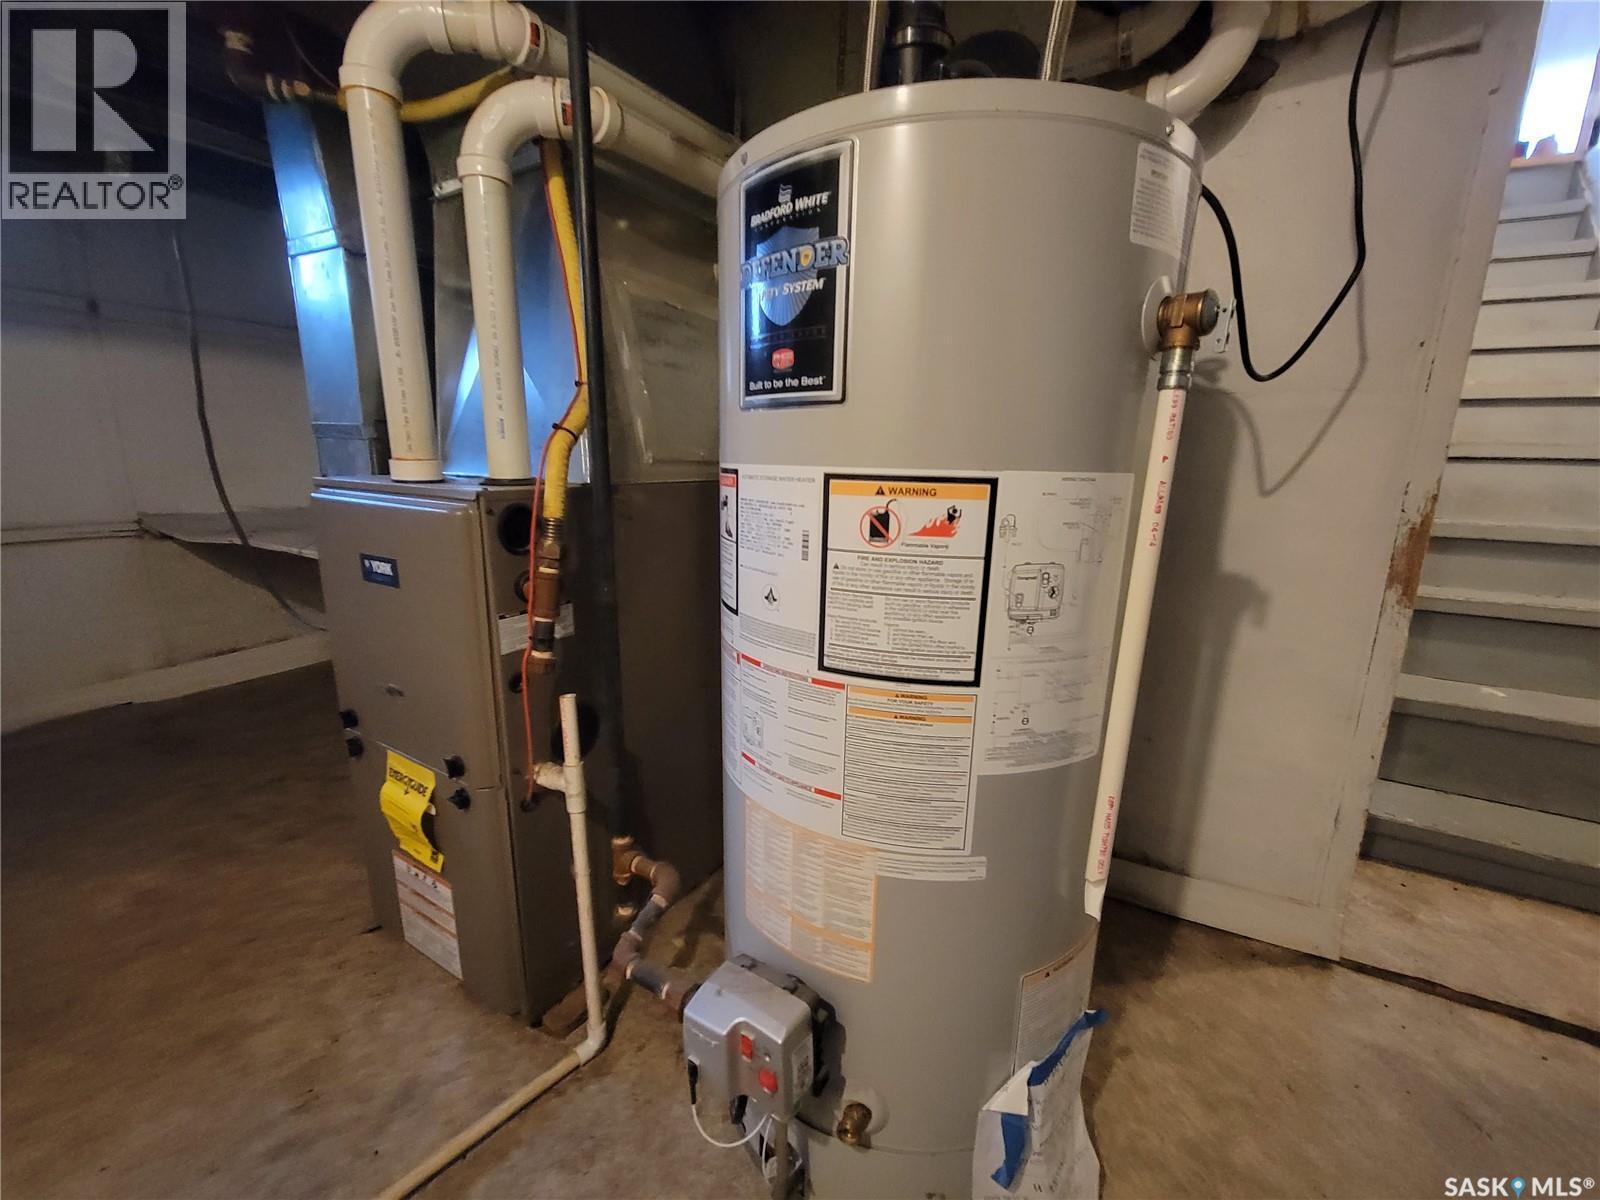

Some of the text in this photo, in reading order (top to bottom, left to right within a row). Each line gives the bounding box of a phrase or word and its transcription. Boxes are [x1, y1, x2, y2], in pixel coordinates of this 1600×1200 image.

[750, 191, 829, 228] BRADFORD WHITE
[783, 277, 826, 295] SYSTEM
[764, 380, 772, 389] to
[773, 379, 783, 389] be
[785, 377, 799, 387] the
[801, 376, 823, 386] Best
[888, 486, 937, 497] WARNING
